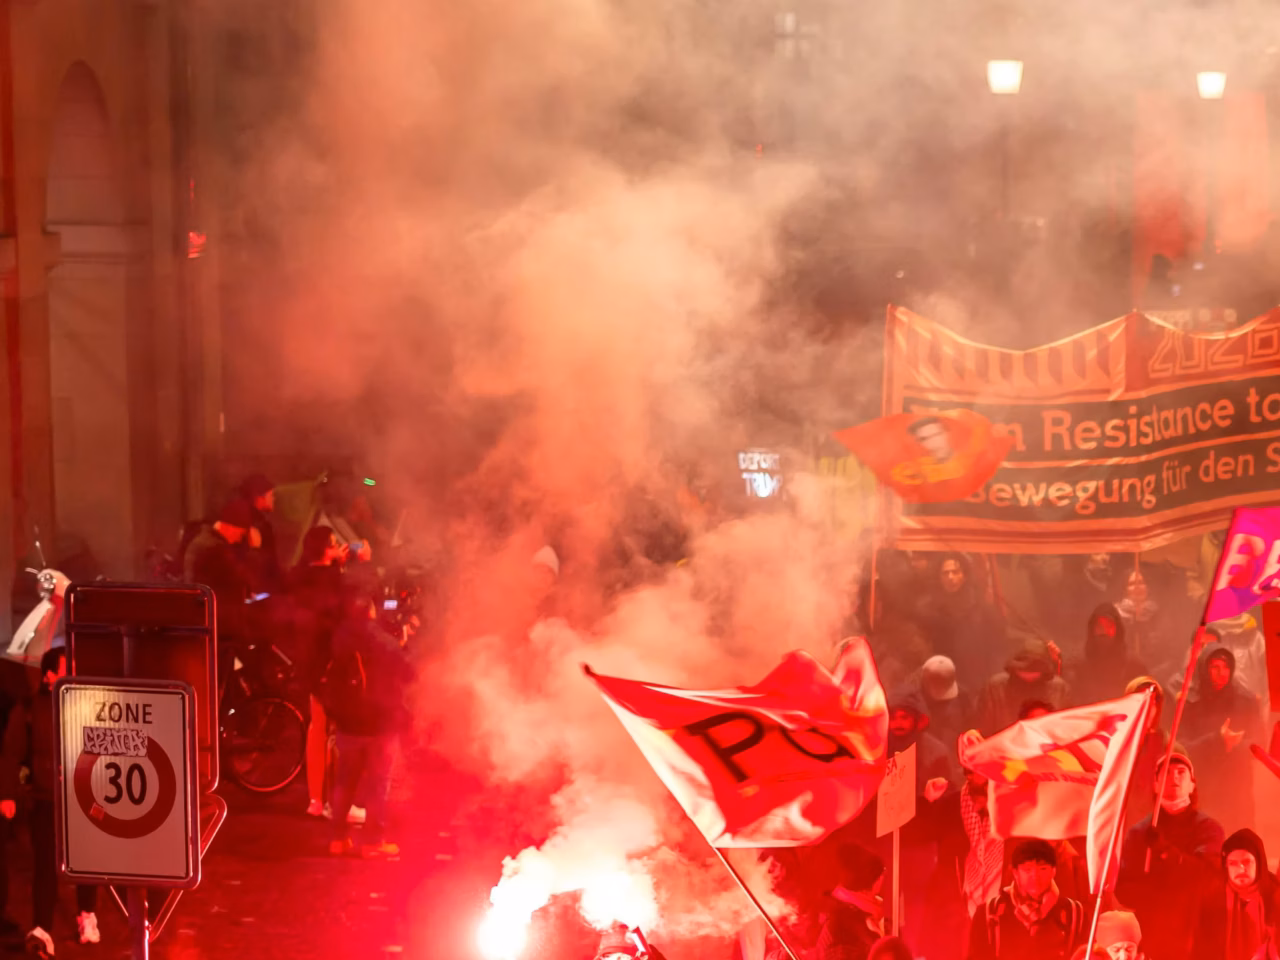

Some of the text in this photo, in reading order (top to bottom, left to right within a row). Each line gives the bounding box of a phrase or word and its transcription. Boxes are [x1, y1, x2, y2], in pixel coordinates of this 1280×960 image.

[1041, 398, 1235, 452] Resistance
[1161, 460, 1192, 496] für
[1199, 450, 1255, 483] den
[95, 702, 153, 725] ZONE
[104, 762, 147, 805] 30
